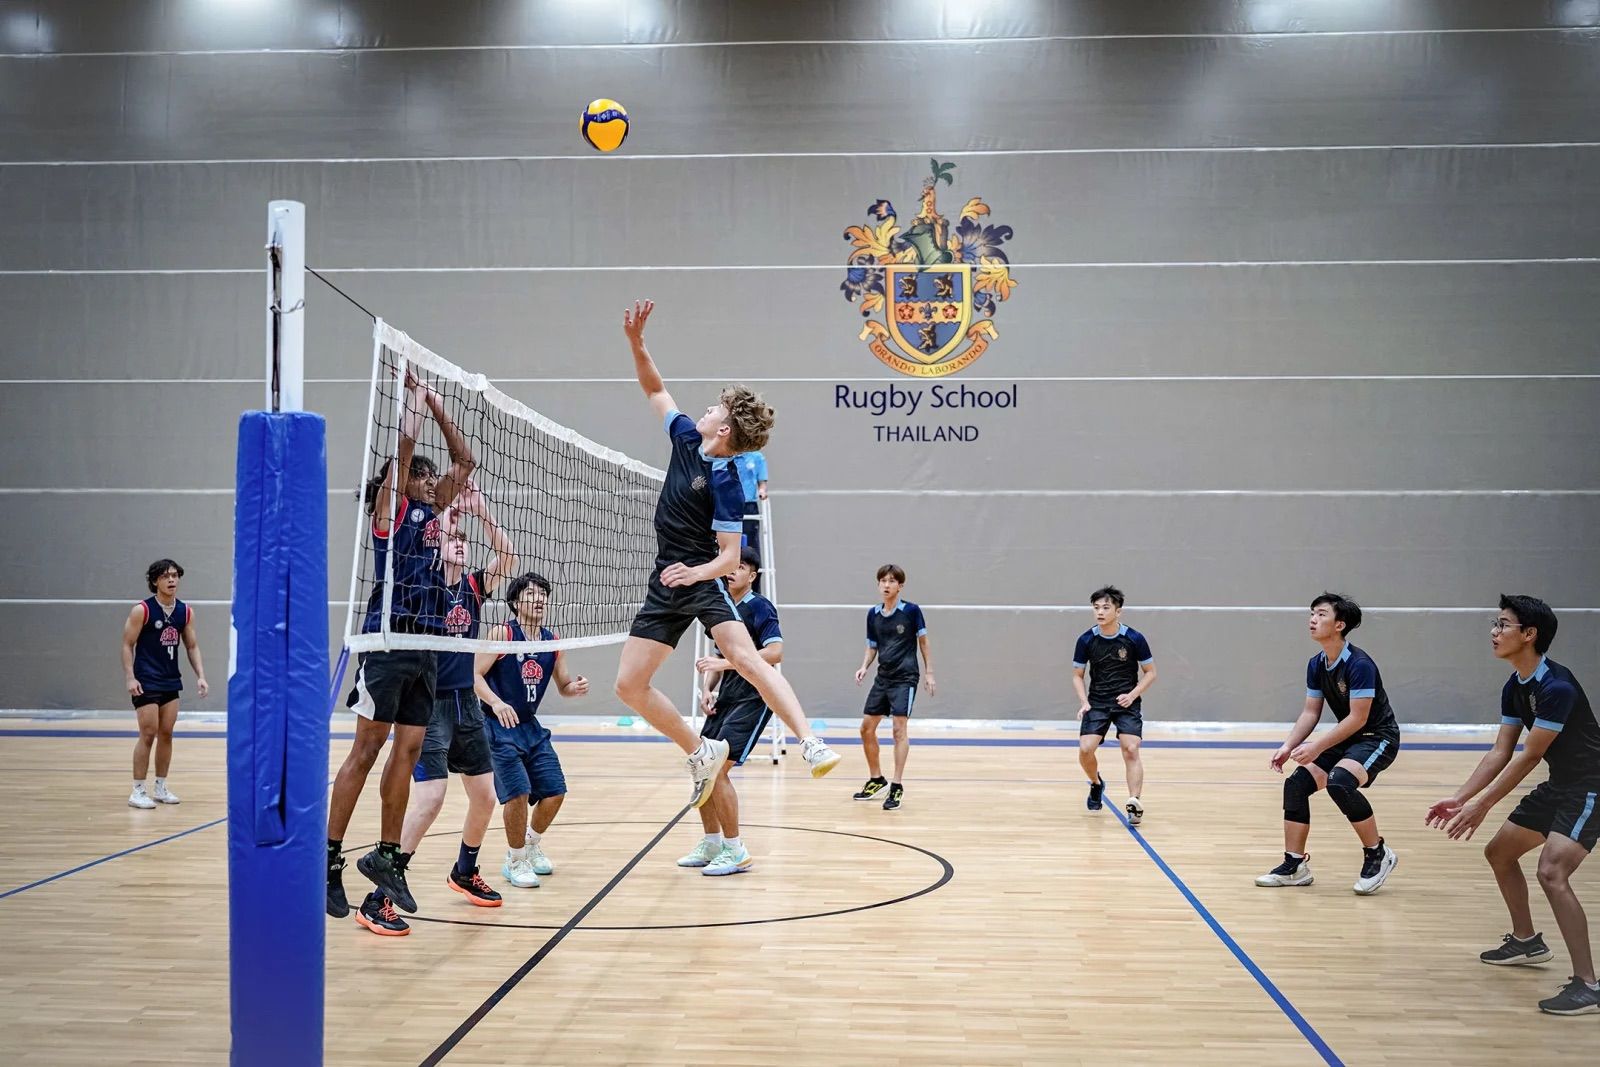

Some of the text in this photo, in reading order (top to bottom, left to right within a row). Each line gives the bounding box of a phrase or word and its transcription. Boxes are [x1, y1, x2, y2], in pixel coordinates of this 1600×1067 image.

[873, 344, 982, 375] ORANDO LABORANDO
[835, 384, 1017, 416] Rugby School
[873, 426, 979, 442] THAILAND
[167, 646, 174, 660] 4
[526, 684, 537, 702] 13
